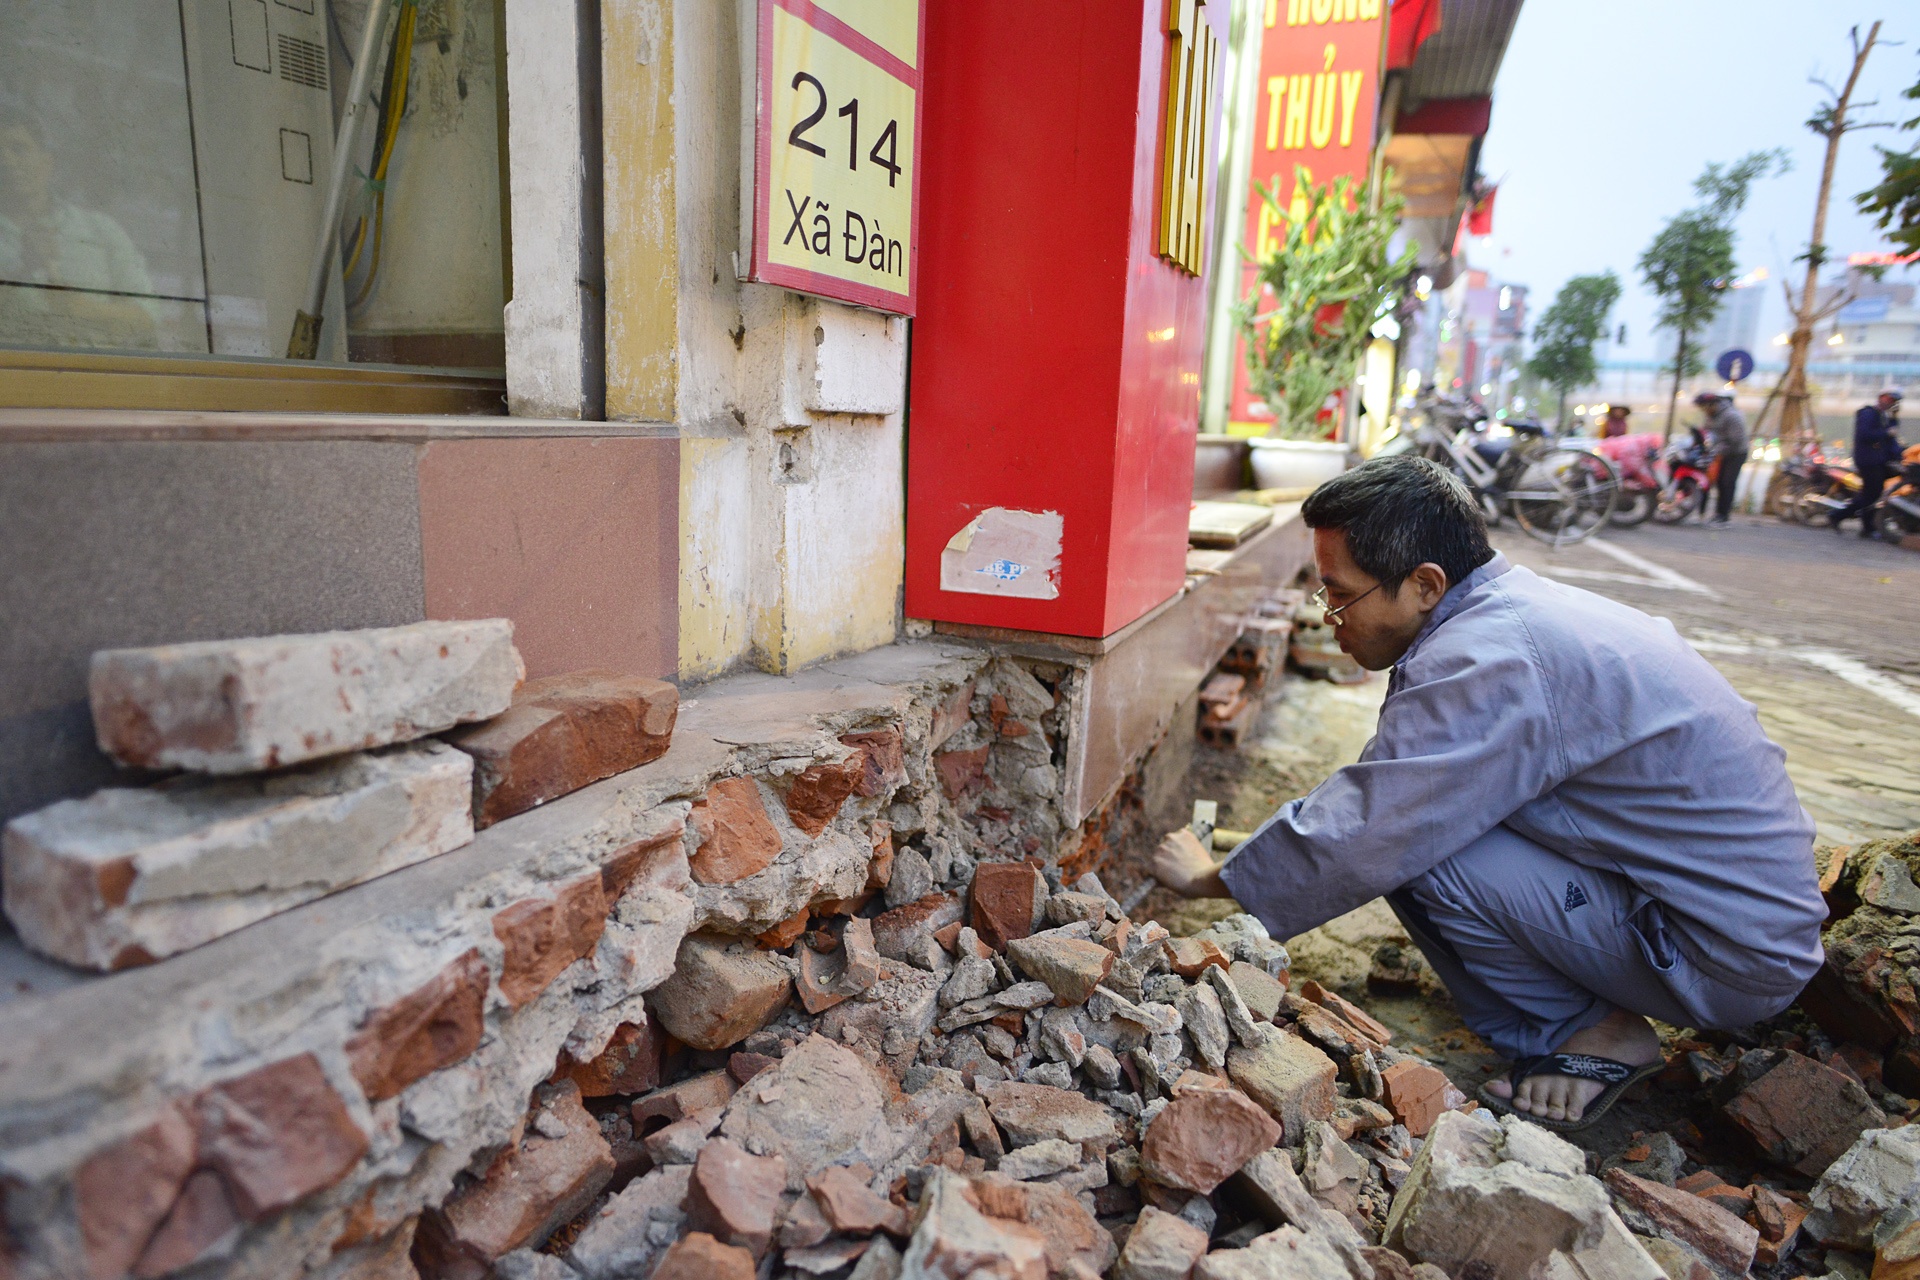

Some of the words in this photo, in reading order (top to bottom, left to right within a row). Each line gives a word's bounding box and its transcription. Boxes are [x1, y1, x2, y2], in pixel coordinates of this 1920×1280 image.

[788, 71, 902, 188] 214
[1266, 42, 1363, 151] THỦY
[783, 188, 831, 257] Xã
[843, 209, 902, 277] Đàn
